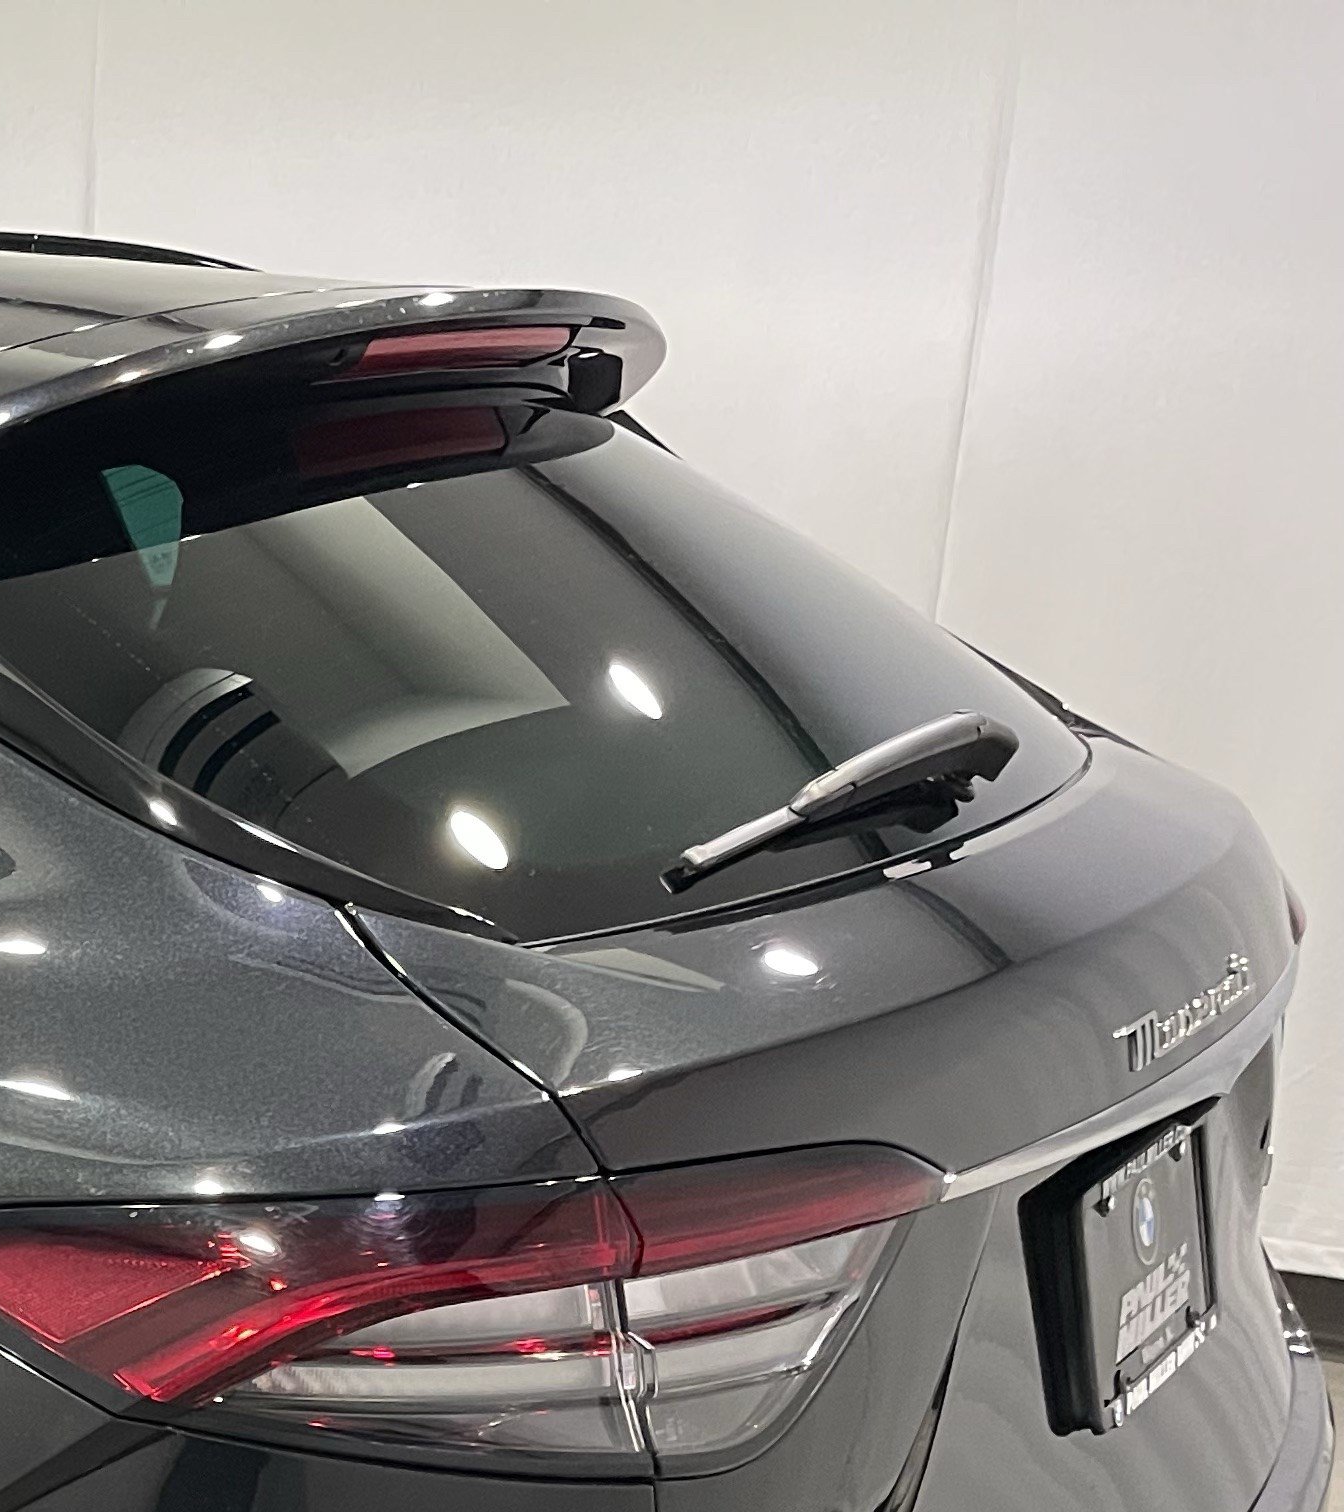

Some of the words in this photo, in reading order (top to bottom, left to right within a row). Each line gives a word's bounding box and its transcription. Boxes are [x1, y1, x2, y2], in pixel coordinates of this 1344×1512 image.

[1113, 953, 1256, 1071] Maserati
[1116, 1269, 1191, 1366] MILLER
[1119, 1262, 1175, 1328] PAUL
